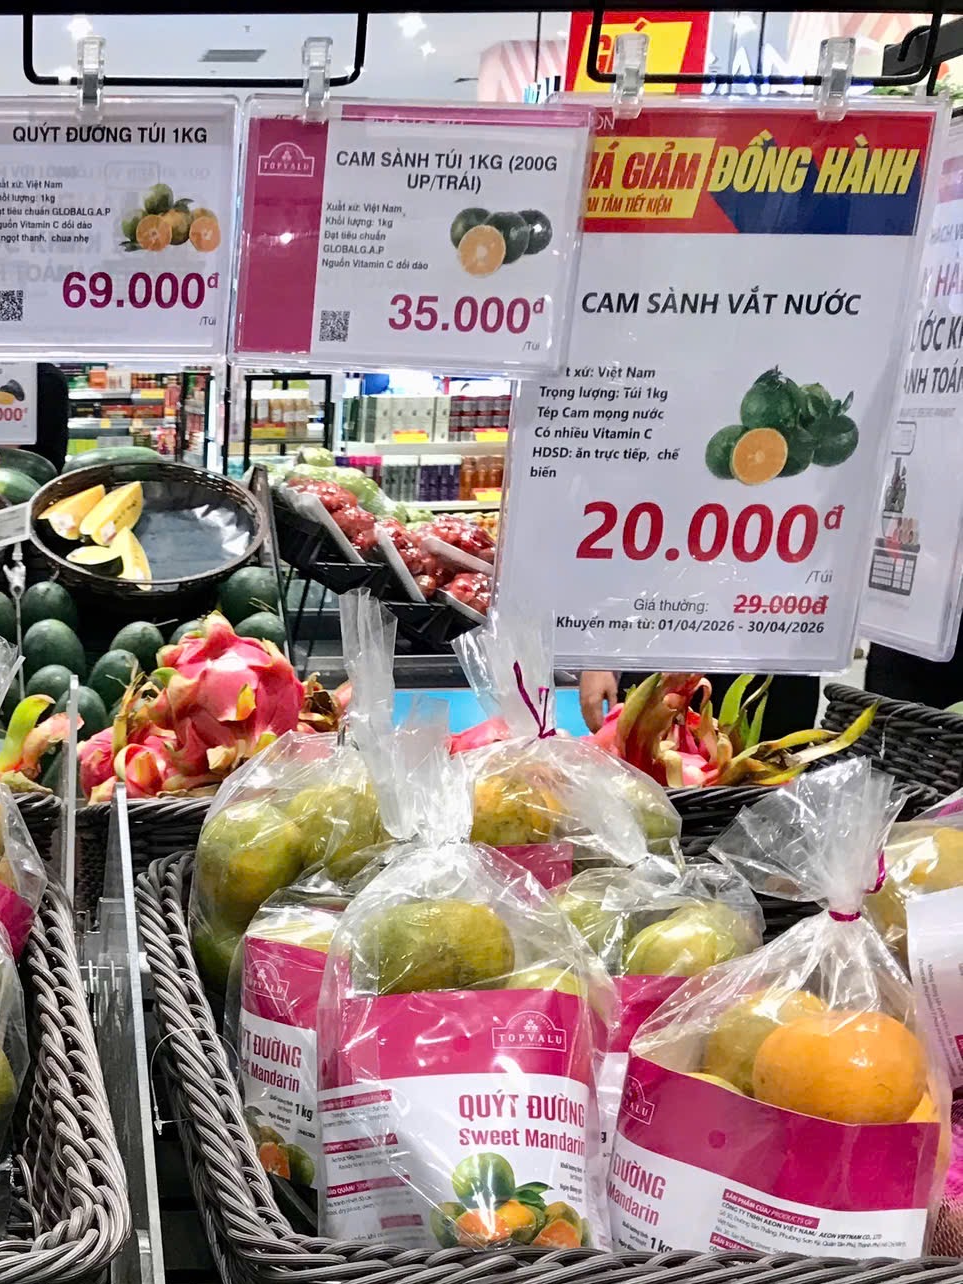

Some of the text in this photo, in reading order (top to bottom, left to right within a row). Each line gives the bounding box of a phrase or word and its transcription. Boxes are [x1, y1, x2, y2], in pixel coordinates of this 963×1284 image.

[12, 121, 61, 142] QUÝT
[137, 122, 166, 143] TÚI
[172, 127, 208, 144] 1KG
[336, 148, 558, 174] CAM SÀNH TÚI 1KG (200G
[621, 141, 702, 190] GIẢM
[707, 129, 920, 195] ĐỒNG HÀNH
[26, 179, 43, 191] Việt
[44, 180, 63, 189] Nam
[407, 171, 482, 195] UP/TRÁI)
[40, 193, 56, 204] 1kg
[600, 193, 674, 216] TÂM TIẾT KIỆM
[7, 206, 22, 216] tiêu
[52, 207, 111, 217] GLOBALG.A.P
[363, 203, 380, 215] Việt
[20, 220, 51, 230] Vitamin
[52, 221, 60, 230] C
[378, 218, 393, 229] 1kg
[1, 234, 20, 245] ngọt
[21, 233, 47, 243] thanh,
[51, 234, 72, 243] chua
[353, 258, 385, 269] Vitamin
[386, 260, 394, 269] C
[581, 286, 862, 316] CAM SÀNH VẮT NƯỚC
[574, 366, 594, 379] xứ:
[598, 366, 623, 380] Việt
[626, 366, 656, 379] Nam
[539, 386, 669, 402] Trọng lượng: Túi 1kg
[537, 406, 665, 422] Tép Cam mọng nước
[534, 426, 653, 440] Có nhiều Vitamin C
[532, 446, 680, 462] HDSD: ăn trực tiếp, chế
[530, 465, 557, 478] biến
[805, 569, 834, 585] /Túi
[633, 598, 655, 613] Giá
[659, 598, 710, 614] thường:
[556, 616, 825, 635] Khuyến từ: 01/04/2026 30/04/2026
[498, 1033, 563, 1045] TOPVALU
[253, 1034, 302, 1068] ĐƯỜNG
[251, 1062, 300, 1093] Mandarin
[295, 1104, 314, 1122] 1 kg
[458, 1088, 585, 1129] QUÝT ĐƯỜNG
[458, 1127, 520, 1147] Sweet
[607, 1181, 659, 1227] Mandarin
[721, 1202, 738, 1212] CÔNG
[746, 1210, 763, 1222] TNHH
[763, 1218, 782, 1228] AEON
[783, 1223, 798, 1233] VIỆT
[650, 1238, 656, 1249] 1
